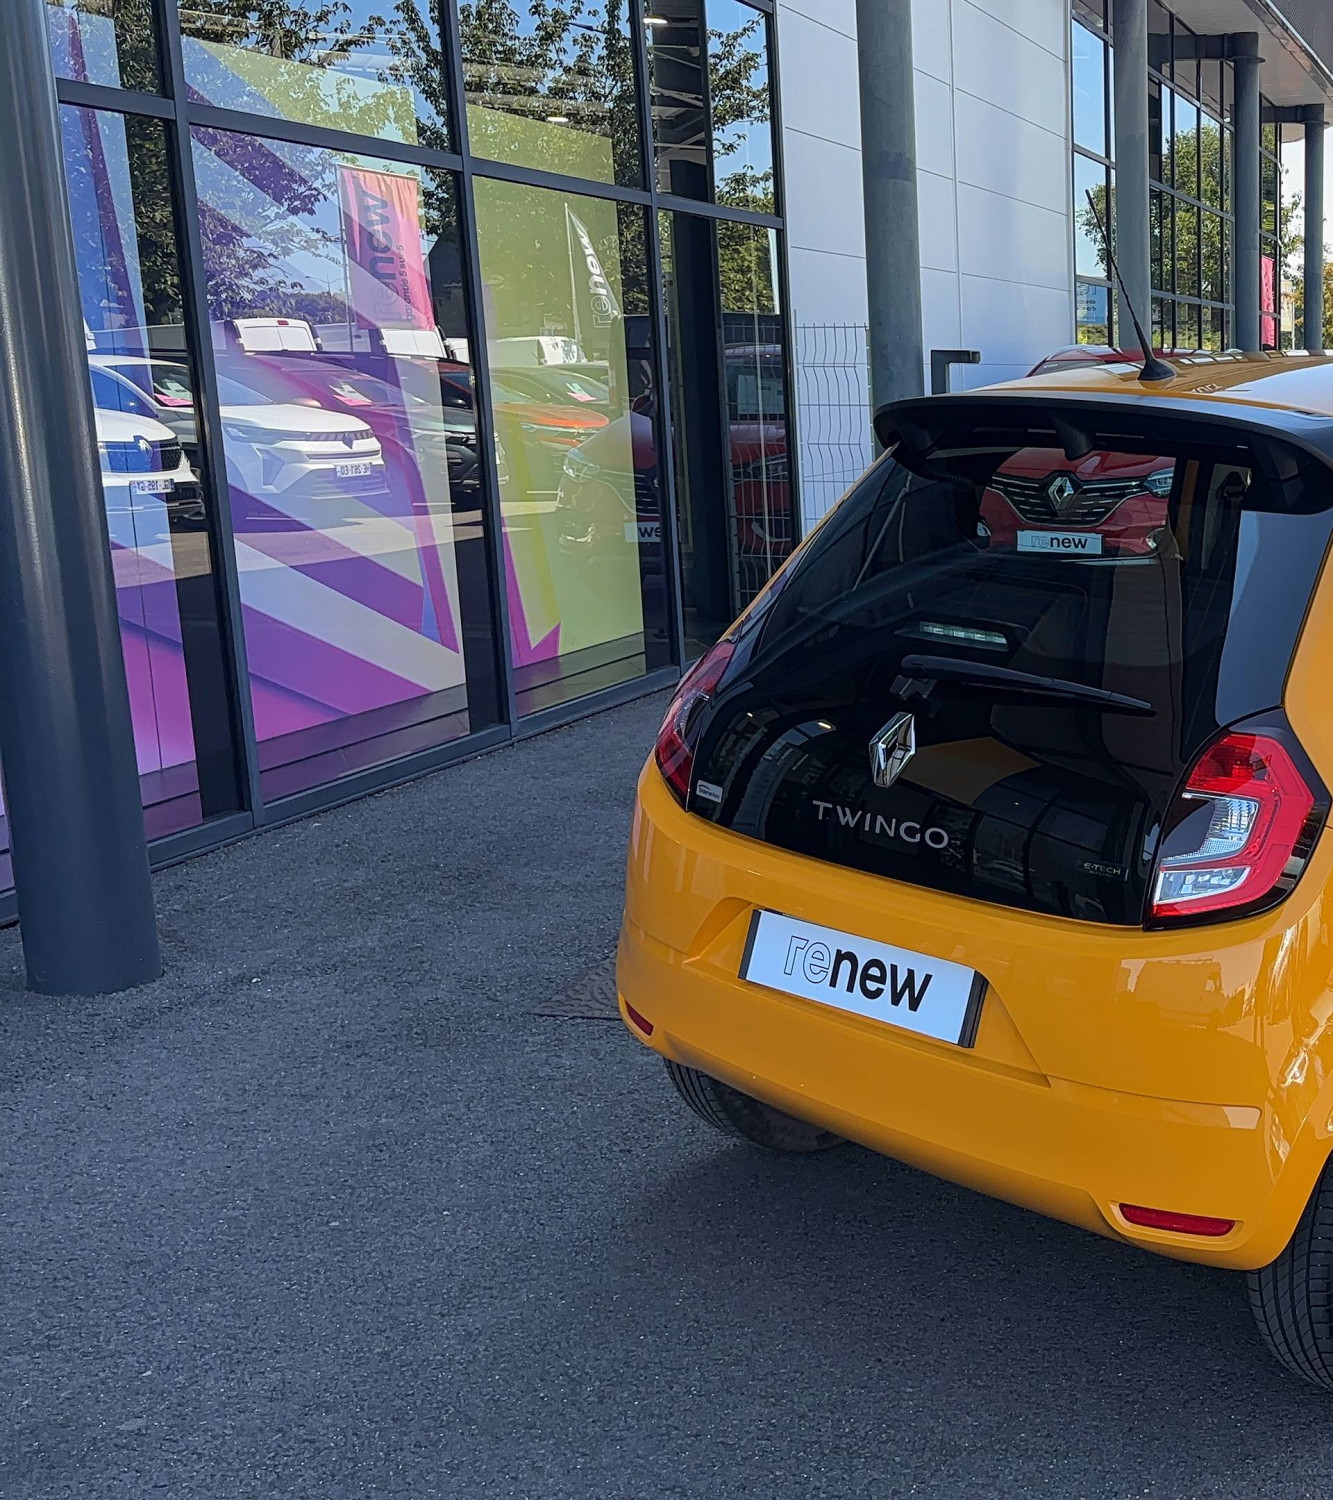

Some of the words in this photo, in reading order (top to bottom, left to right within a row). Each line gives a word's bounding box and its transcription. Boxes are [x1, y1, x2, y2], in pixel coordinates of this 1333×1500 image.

[352, 175, 398, 321] renew
[576, 227, 612, 328] renew
[1031, 535, 1088, 549] renew
[812, 800, 949, 849] TWINGO
[783, 935, 934, 1012] renew
